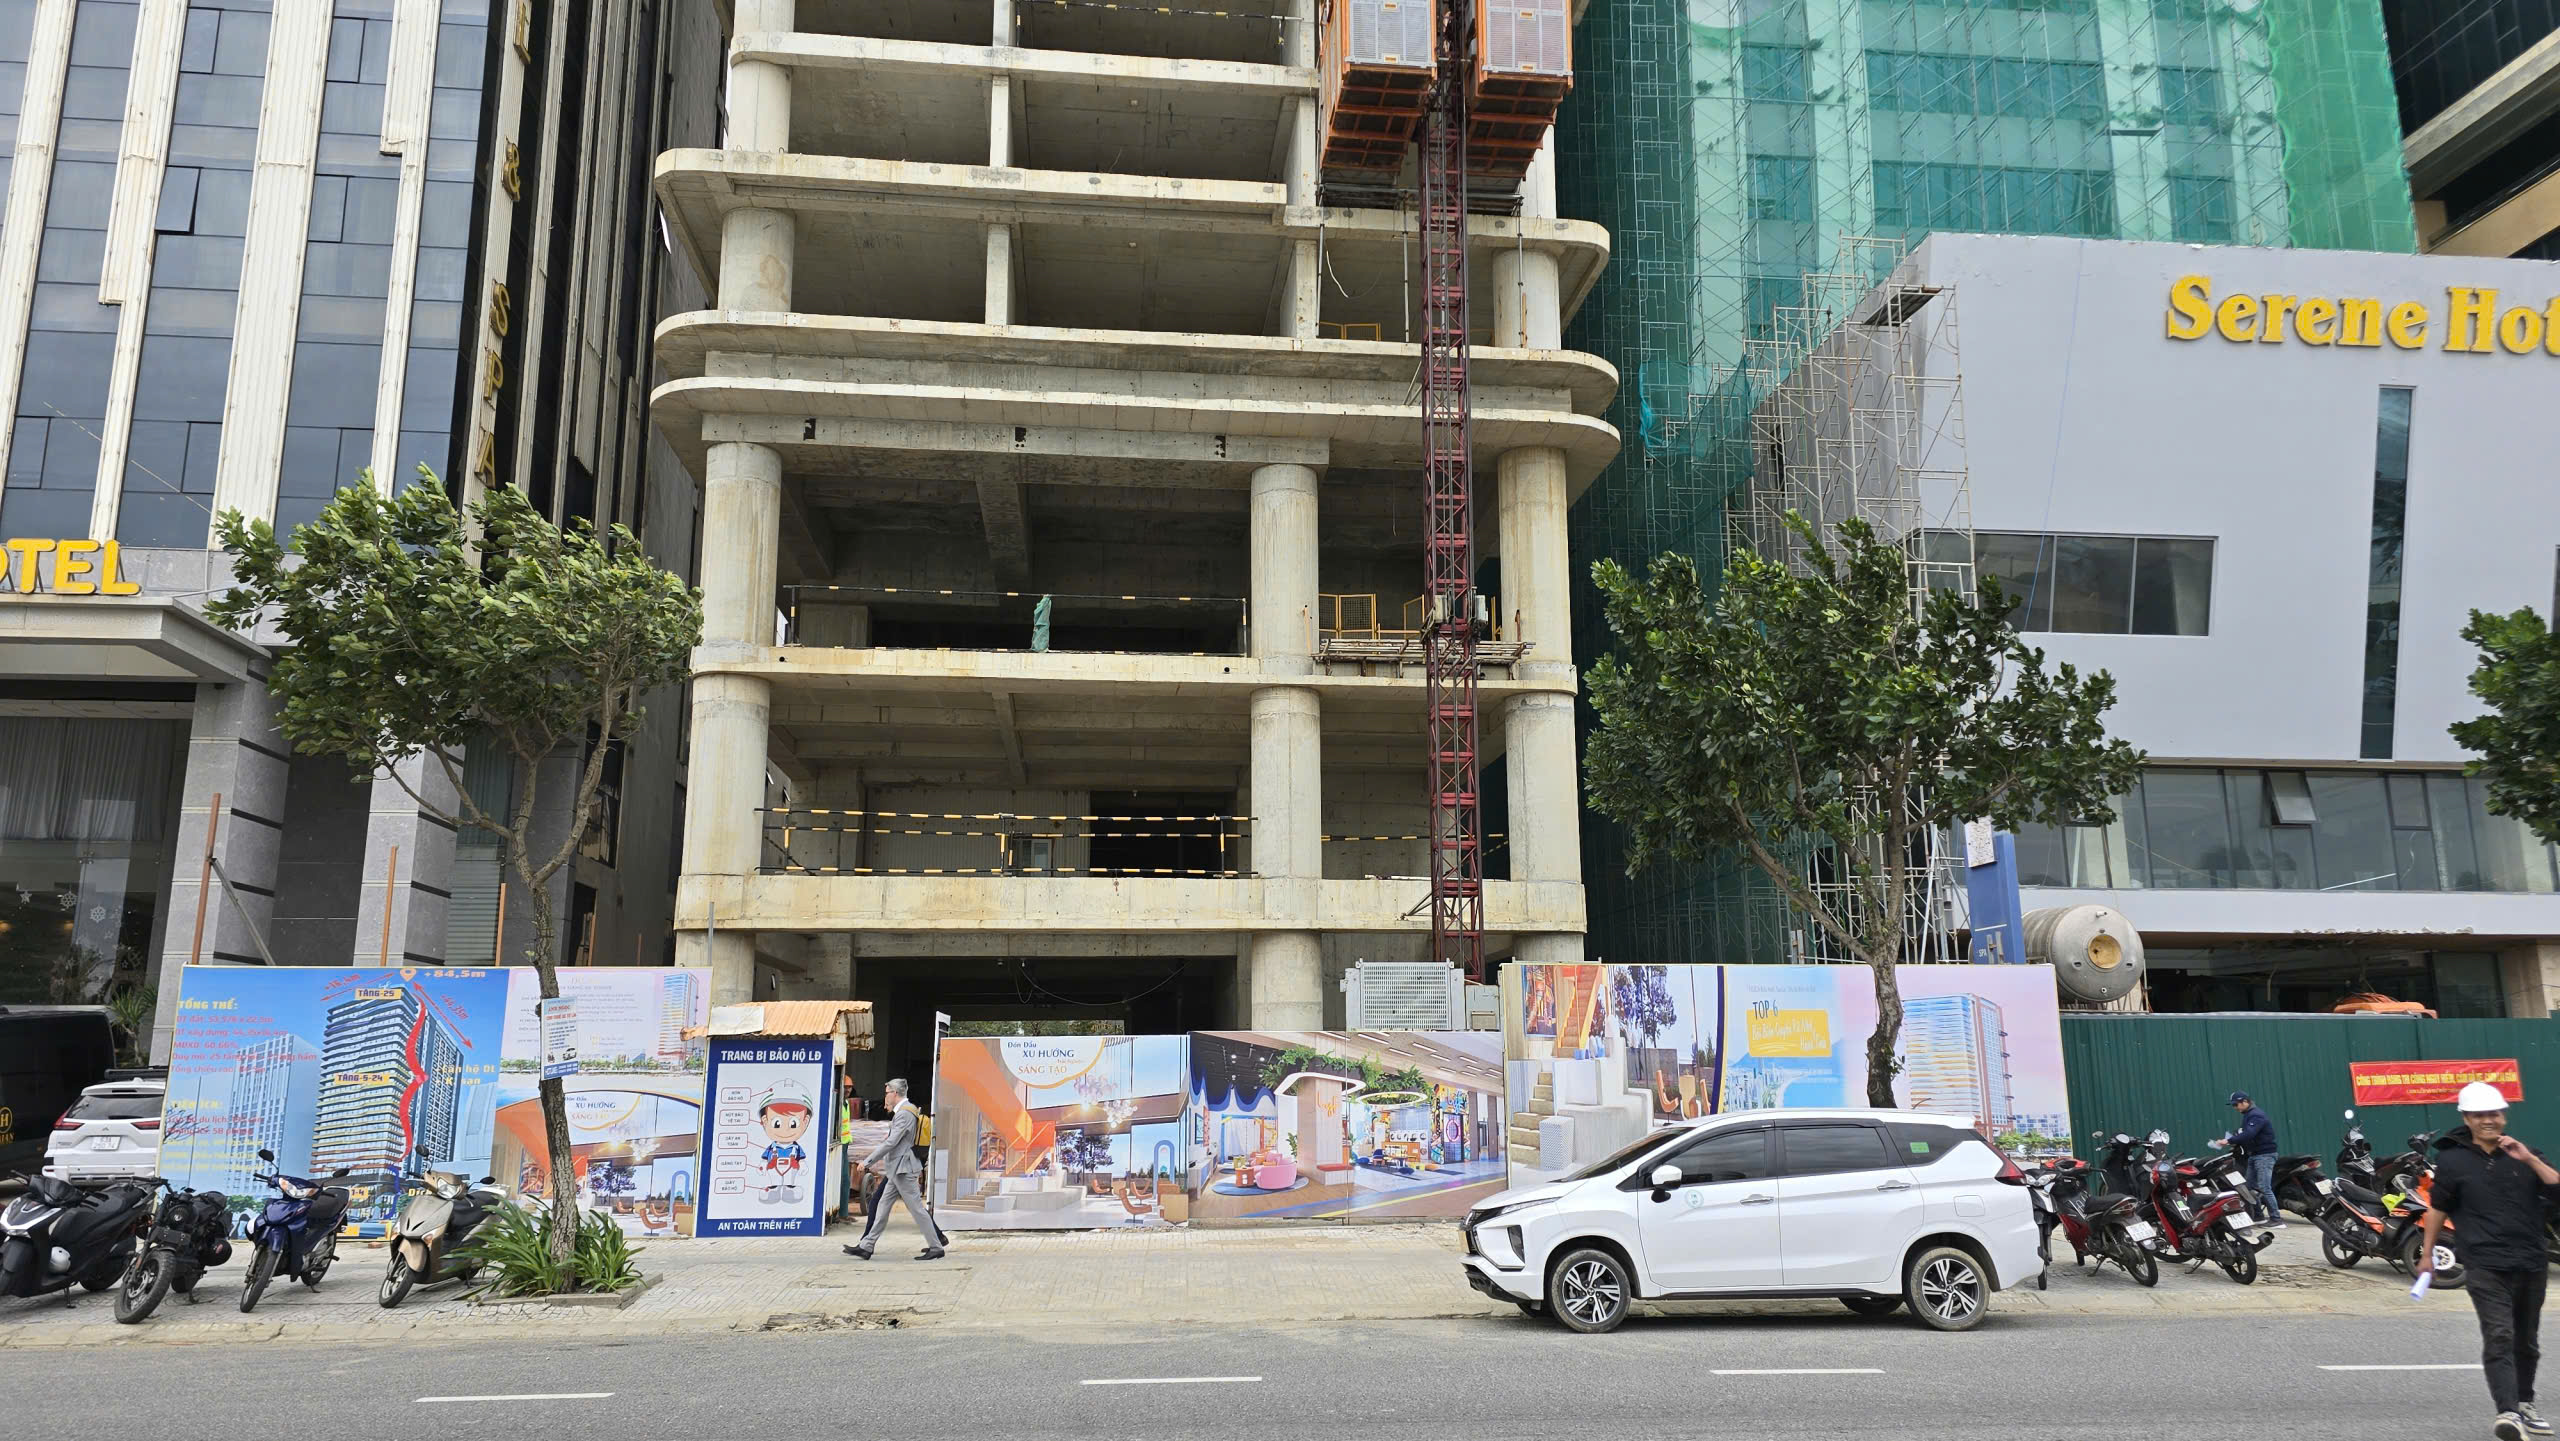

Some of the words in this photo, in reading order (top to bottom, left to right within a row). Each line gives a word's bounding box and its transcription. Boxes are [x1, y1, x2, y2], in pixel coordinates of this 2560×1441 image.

[2166, 274, 2430, 349] Serene
[474, 282, 511, 489] SPA
[0, 538, 142, 595] TEL
[1752, 1000, 1770, 1020] TOP
[1772, 1000, 1779, 1017] 6
[721, 1050, 754, 1061] TRANG
[756, 1050, 767, 1063] BỊ
[769, 1046, 790, 1061] BẢO
[792, 1048, 805, 1063] HỘ
[809, 1050, 822, 1061] LĐ
[1022, 1050, 1036, 1058] XU
[1038, 1047, 1074, 1058] HƯỚNG
[1018, 1064, 1045, 1074] SÁNG
[1048, 1065, 1067, 1076] TẠO
[718, 1222, 731, 1231] AN
[732, 1220, 756, 1231] TOÀN
[758, 1220, 782, 1230] TRÊN
[784, 1218, 801, 1230] HẾT
